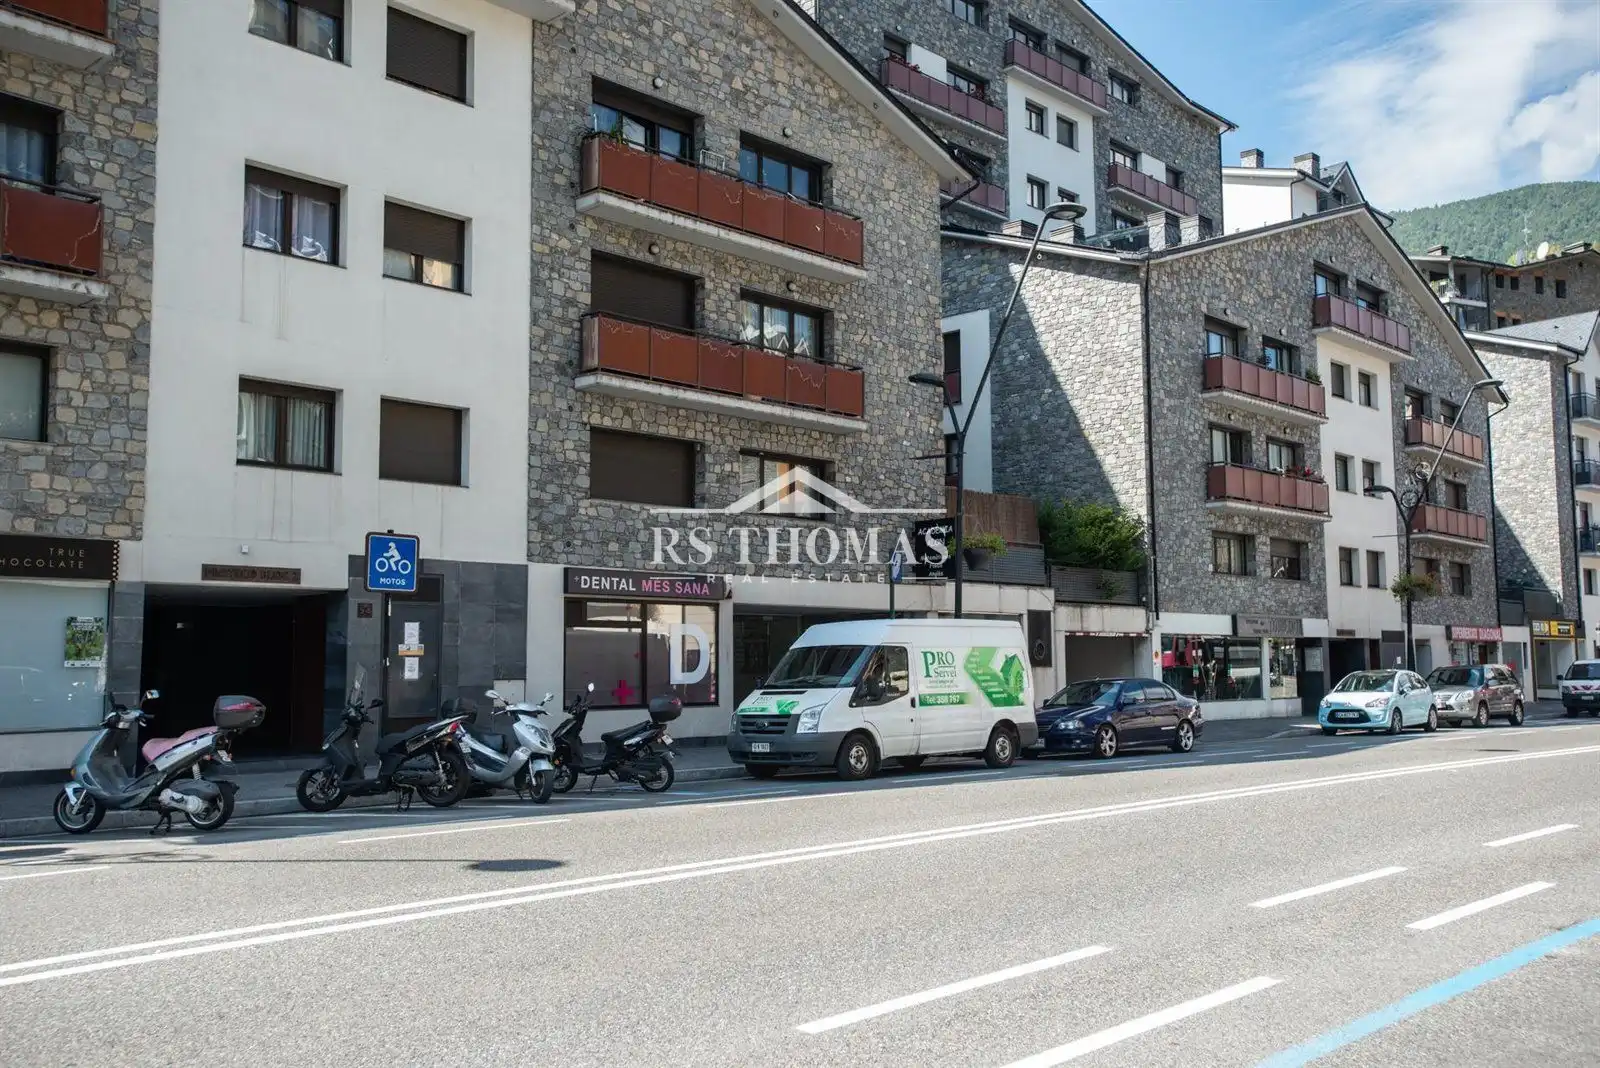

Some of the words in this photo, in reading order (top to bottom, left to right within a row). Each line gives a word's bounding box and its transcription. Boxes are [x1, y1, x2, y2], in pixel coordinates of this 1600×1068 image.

[49, 547, 85, 558] TRUE
[379, 577, 406, 586] MOTOS
[580, 575, 637, 591] DENTAL
[675, 581, 710, 595] SANA
[669, 623, 710, 685] D
[920, 651, 955, 678] PRO
